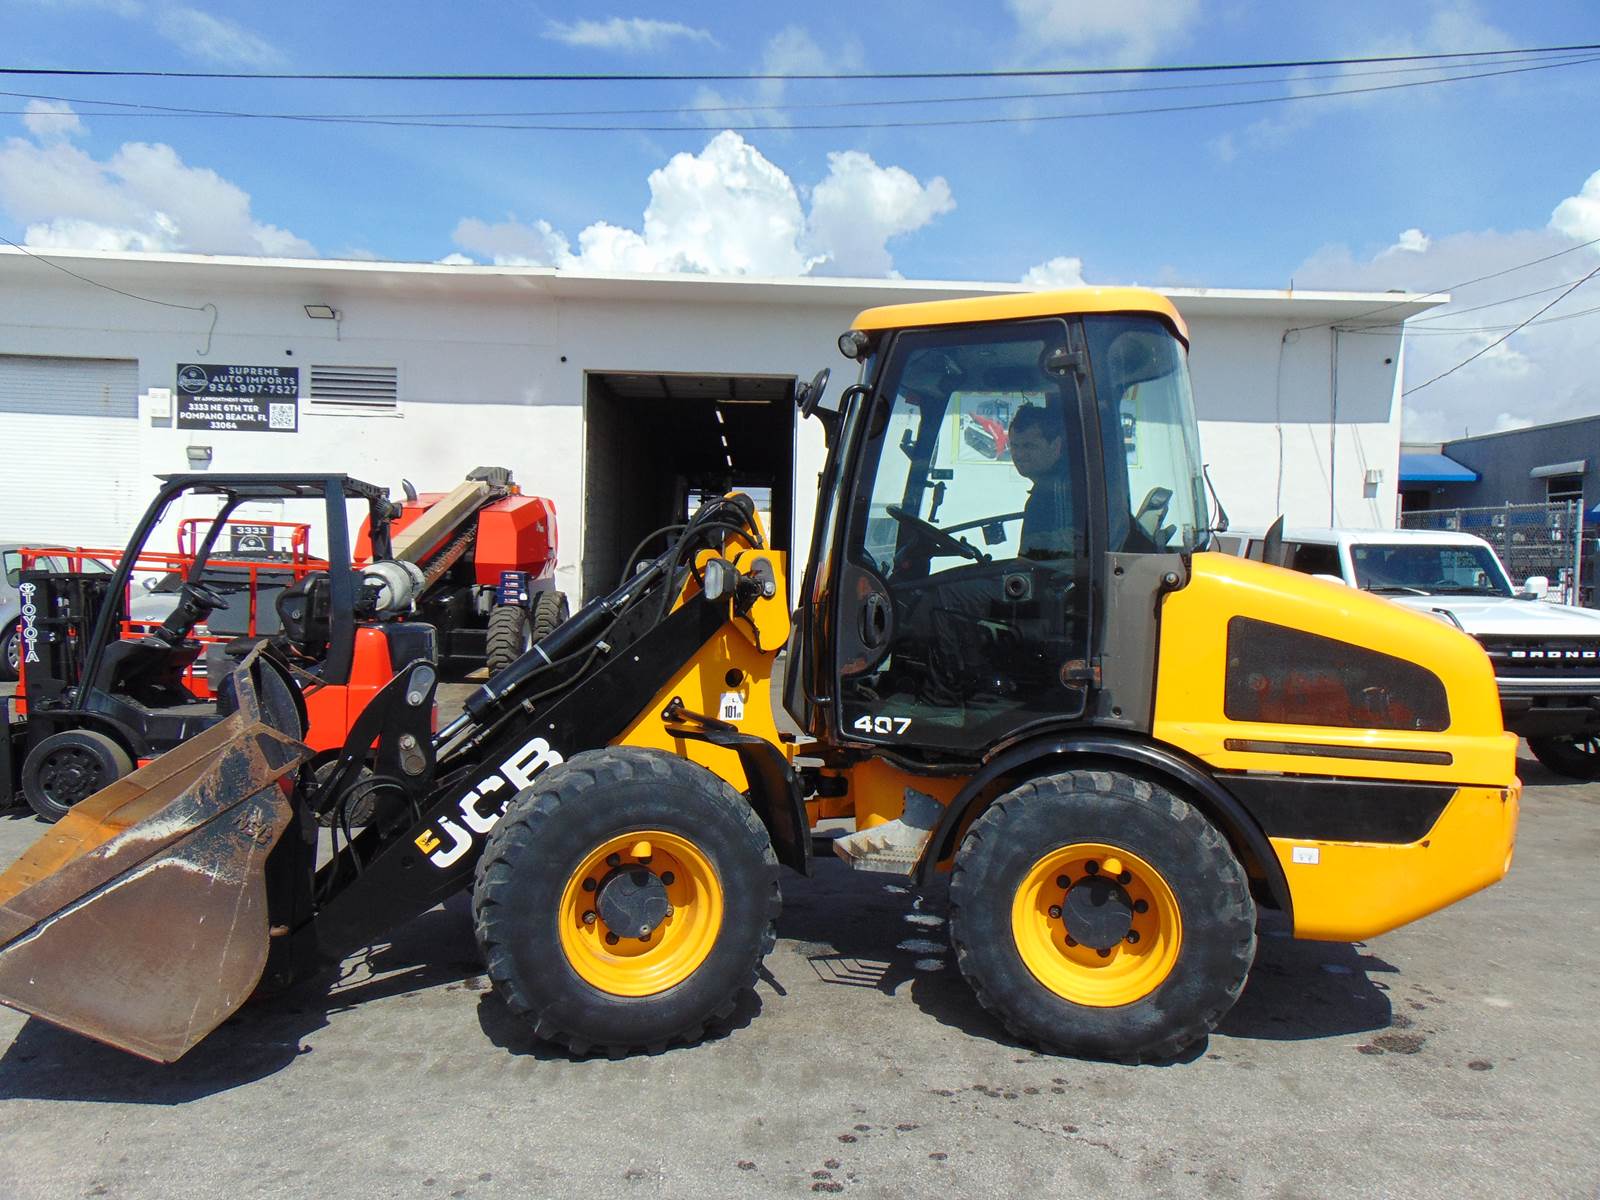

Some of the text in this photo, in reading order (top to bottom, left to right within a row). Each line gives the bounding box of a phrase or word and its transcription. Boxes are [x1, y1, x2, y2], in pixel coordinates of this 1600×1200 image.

[228, 367, 280, 376] SUPREME
[212, 375, 243, 384] AUTO
[246, 377, 296, 385] IMPORTS
[208, 384, 298, 394] 954-907-7527
[188, 403, 209, 411] 3333
[223, 404, 241, 412] 6TH
[242, 404, 260, 412] TER
[180, 412, 268, 422] POMPANO BEACH, FL
[209, 421, 238, 429] 33064
[236, 526, 267, 535] 3333
[21, 592, 40, 663] TOYOTA
[724, 705, 737, 718] 101
[854, 715, 912, 735] 407
[430, 737, 564, 869] JCB
